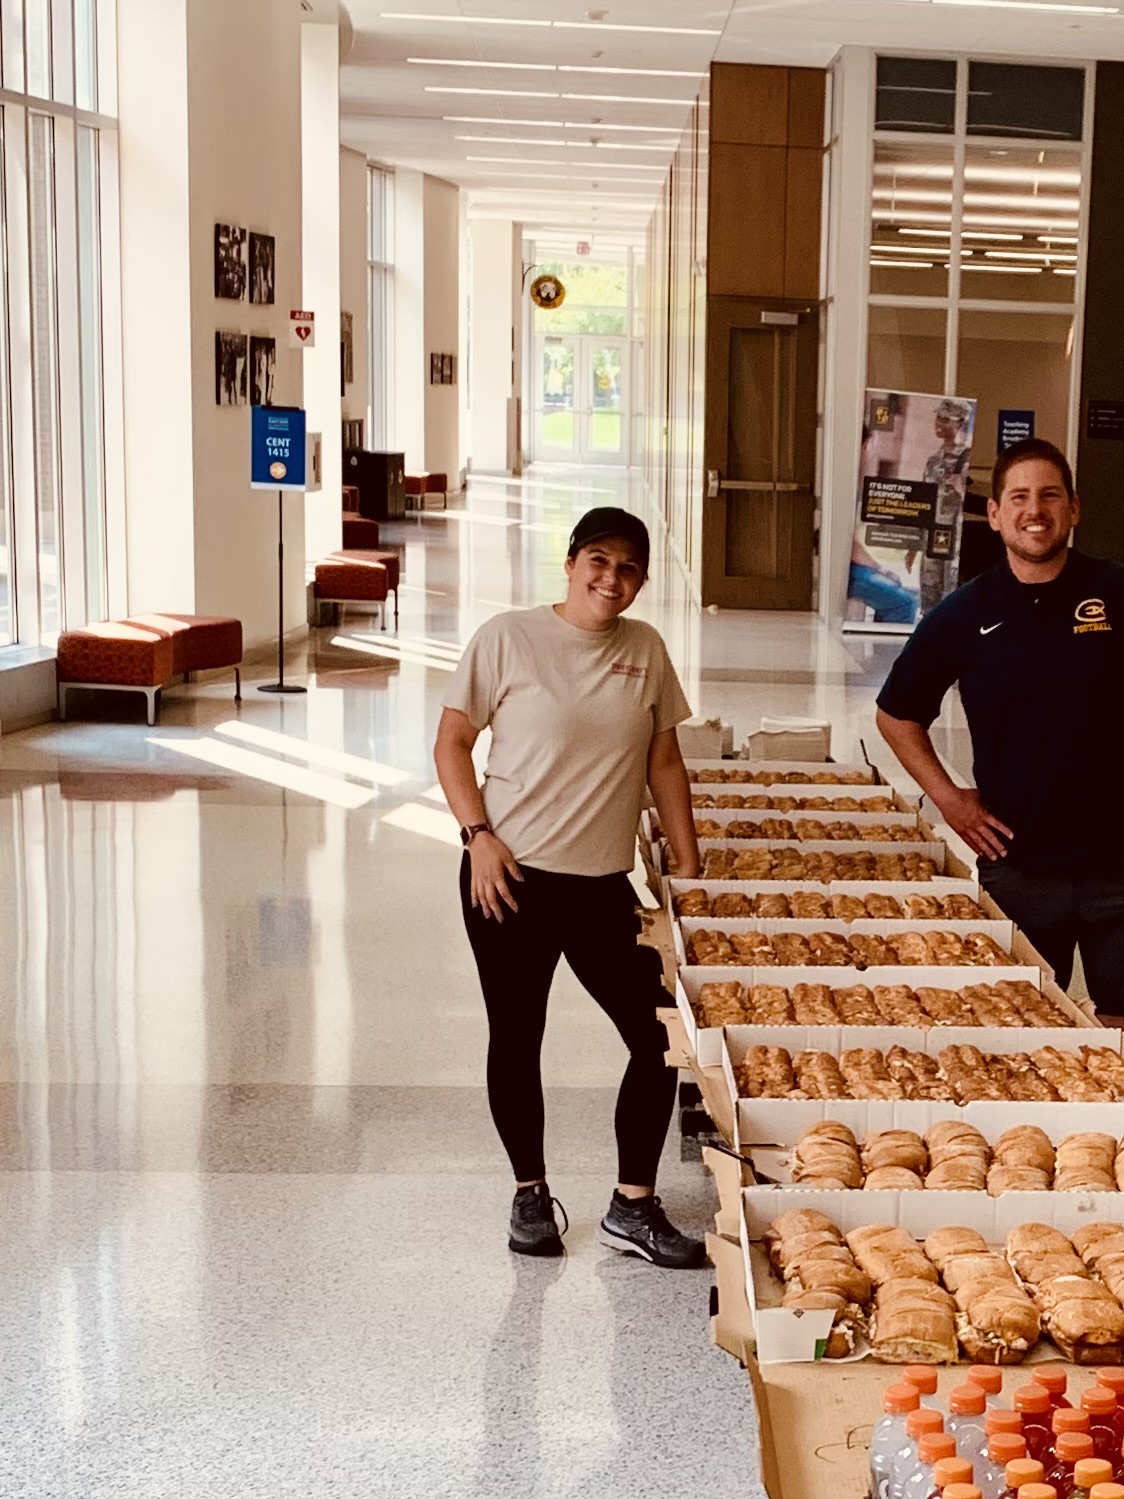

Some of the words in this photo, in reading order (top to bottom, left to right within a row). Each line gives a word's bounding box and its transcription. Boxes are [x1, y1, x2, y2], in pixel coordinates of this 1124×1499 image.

[294, 312, 313, 320] AED
[266, 437, 291, 447] CENT
[267, 448, 290, 458] 1415
[1073, 622, 1112, 634] FOOTBALL
